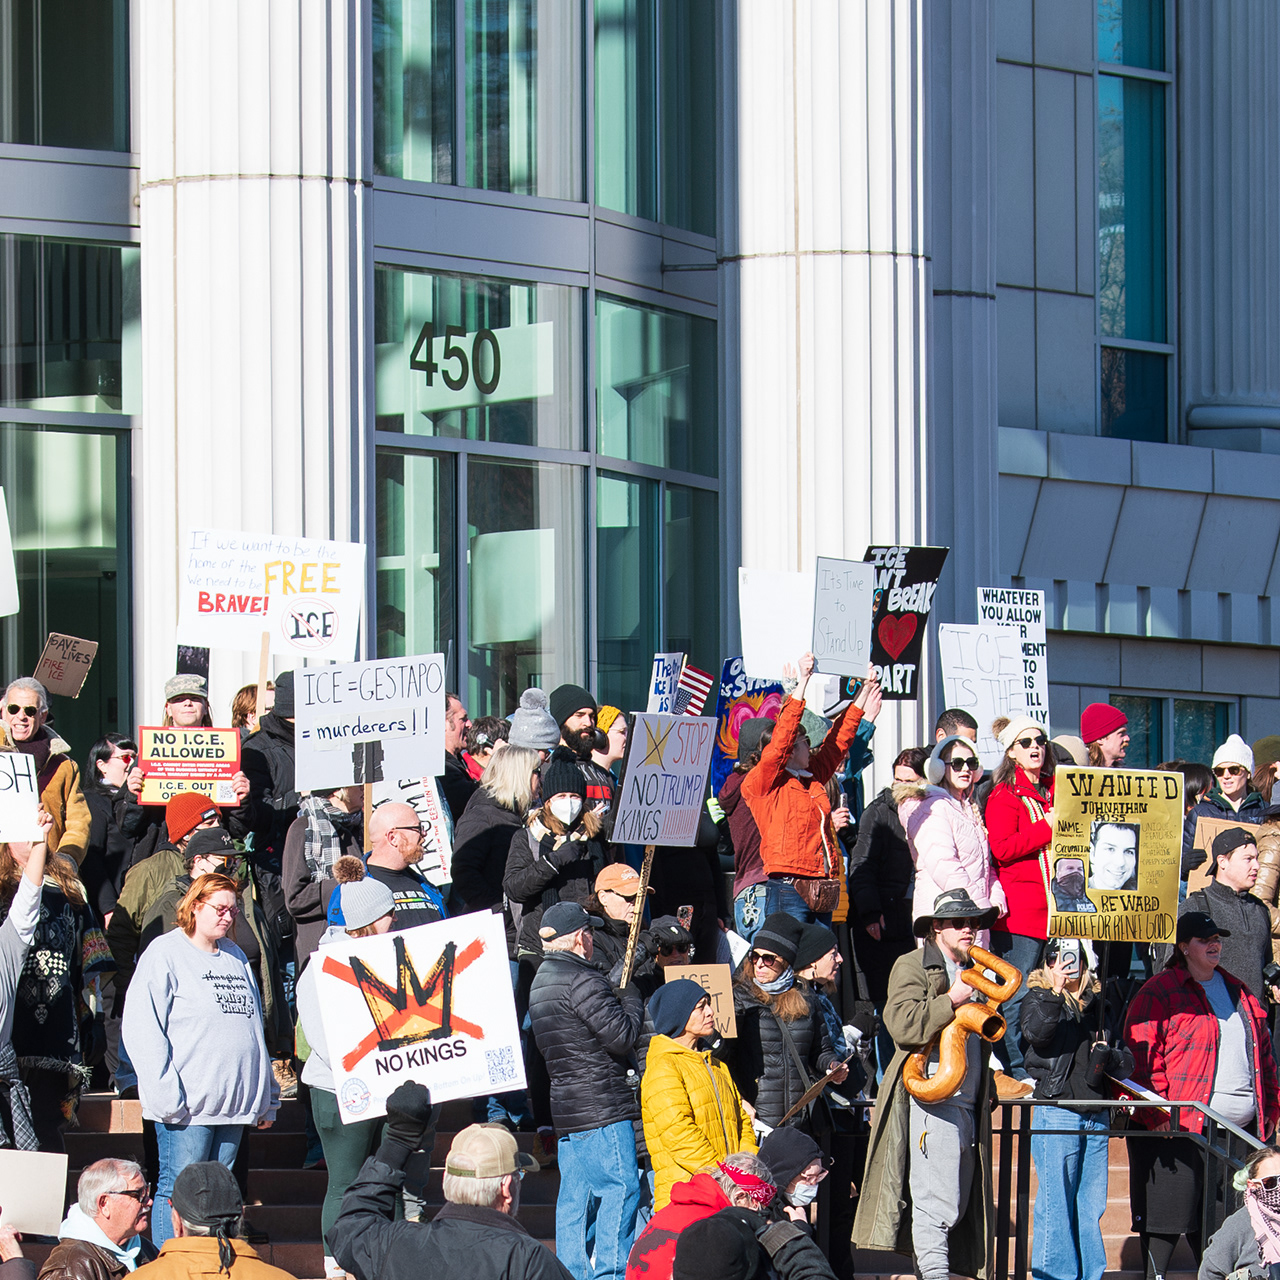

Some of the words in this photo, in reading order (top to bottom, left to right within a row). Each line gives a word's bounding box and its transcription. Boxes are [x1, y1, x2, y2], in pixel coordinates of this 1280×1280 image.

[410, 321, 501, 394] 450
[190, 531, 210, 550] If
[217, 540, 238, 550] we
[242, 539, 272, 552] want
[274, 541, 290, 554] to
[294, 542, 310, 557] be
[317, 545, 336, 559] the
[871, 547, 909, 568] ICE
[189, 553, 217, 569] home
[221, 558, 234, 568] of
[240, 560, 256, 573] the
[264, 560, 340, 595] FREE
[206, 577, 231, 587] need
[235, 578, 245, 588] to
[249, 578, 262, 590] be
[821, 569, 842, 591] It's
[198, 591, 269, 616] BRAVE!
[834, 598, 846, 612] to
[982, 588, 1039, 606] WHATEVER
[981, 605, 1003, 620] YOU
[1006, 607, 1041, 623] ALLOW
[290, 612, 334, 639] ICE
[50, 634, 80, 652] SAVE
[946, 630, 1016, 676] ICE
[43, 658, 66, 670] FIRE
[62, 651, 91, 665] LIVES
[48, 670, 64, 681] ICE
[303, 671, 342, 705] ICE
[359, 663, 443, 701] GESTAPO
[947, 677, 977, 708] IS
[981, 679, 1023, 716] THE
[153, 733, 176, 744] NO
[184, 734, 224, 745] I.C.E.
[673, 721, 713, 767] STOP!
[150, 748, 225, 758] ALLOWED
[159, 782, 187, 790] I.C.E.
[191, 782, 214, 790] OUT
[630, 774, 659, 806] NO
[661, 773, 704, 806] TRUMP!
[1066, 773, 1178, 800] WANTED
[1081, 801, 1148, 814] JOHNATHAN
[618, 809, 661, 841] KINGS
[1101, 895, 1160, 913] REWARD
[1090, 915, 1111, 939] FOR
[1146, 913, 1175, 940] GOOD
[375, 1053, 403, 1075] NO
[407, 1039, 467, 1068] KINGS
